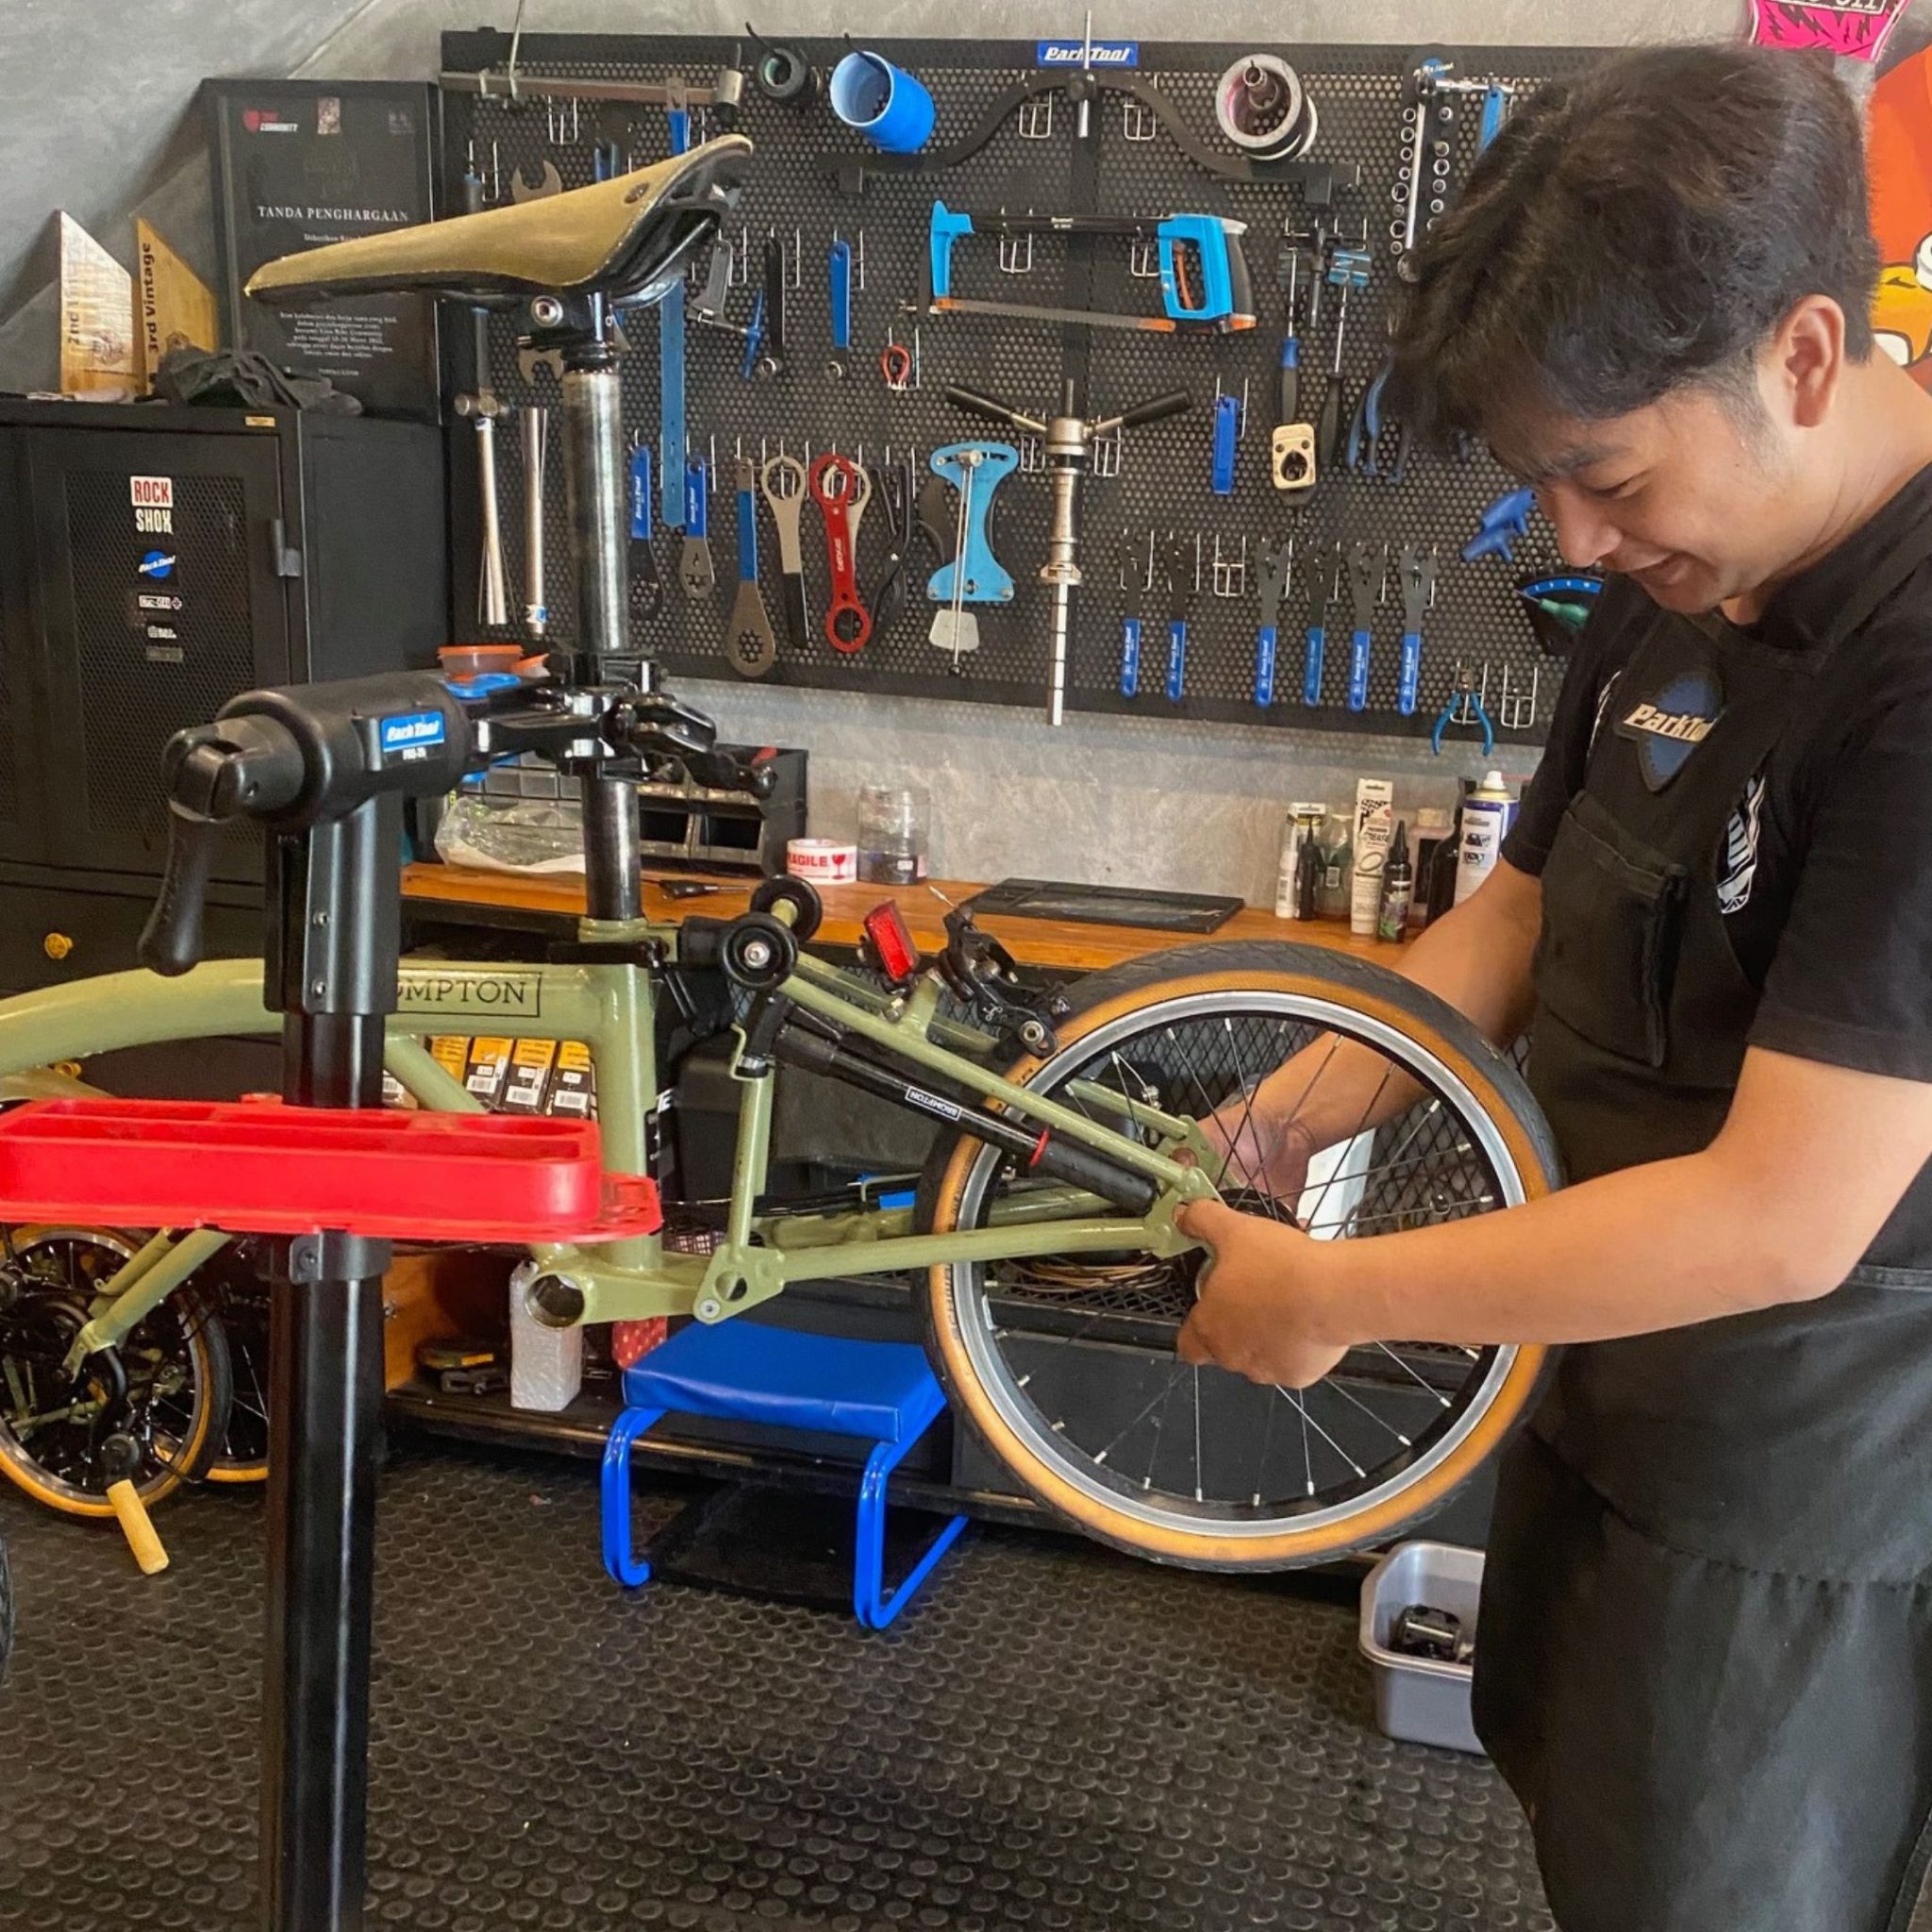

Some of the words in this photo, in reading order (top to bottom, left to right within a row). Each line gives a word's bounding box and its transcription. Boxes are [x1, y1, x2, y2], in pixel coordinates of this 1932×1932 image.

[257, 206, 303, 219] TANDA
[307, 207, 408, 222] PENGHARGAAN
[142, 242, 157, 318] Vintage
[145, 322, 159, 353] 3rd
[134, 480, 170, 503] ROCK
[135, 508, 174, 535] SHOX
[397, 978, 527, 1005] MPTON
